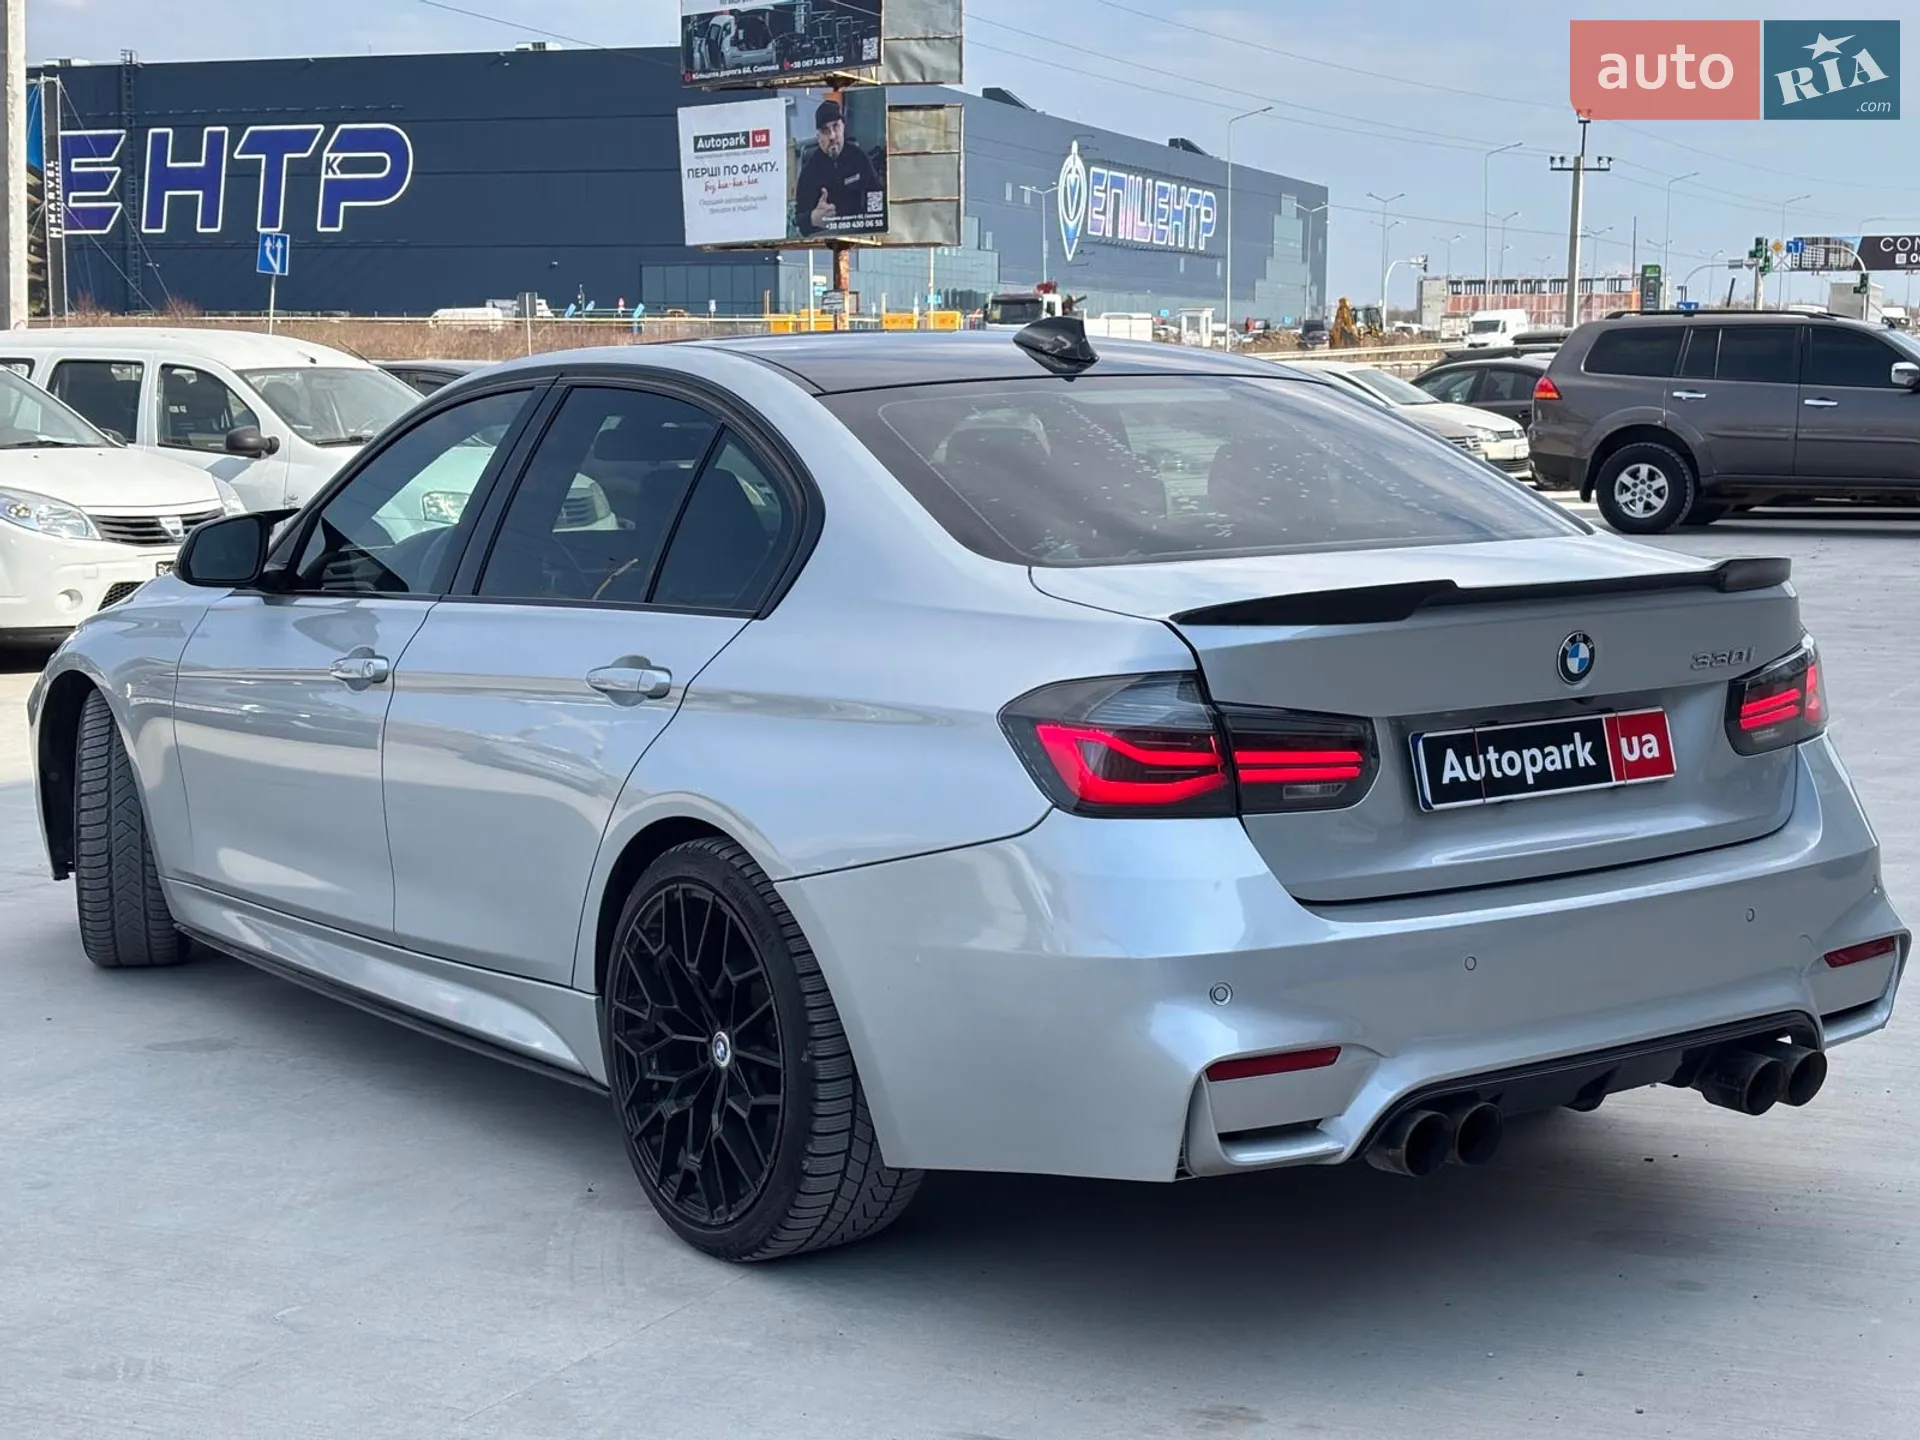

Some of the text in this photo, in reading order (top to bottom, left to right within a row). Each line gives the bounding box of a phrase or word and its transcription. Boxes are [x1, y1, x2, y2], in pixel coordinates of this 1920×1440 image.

[697, 132, 767, 149] Autopark ua
[46, 160, 56, 224] MARVEL
[687, 161, 779, 179] ПЕРШІ ПО ФАКТУ.
[1087, 166, 1217, 251] ЕПІЦЕНТР
[1441, 731, 1660, 785] Autopark ua
